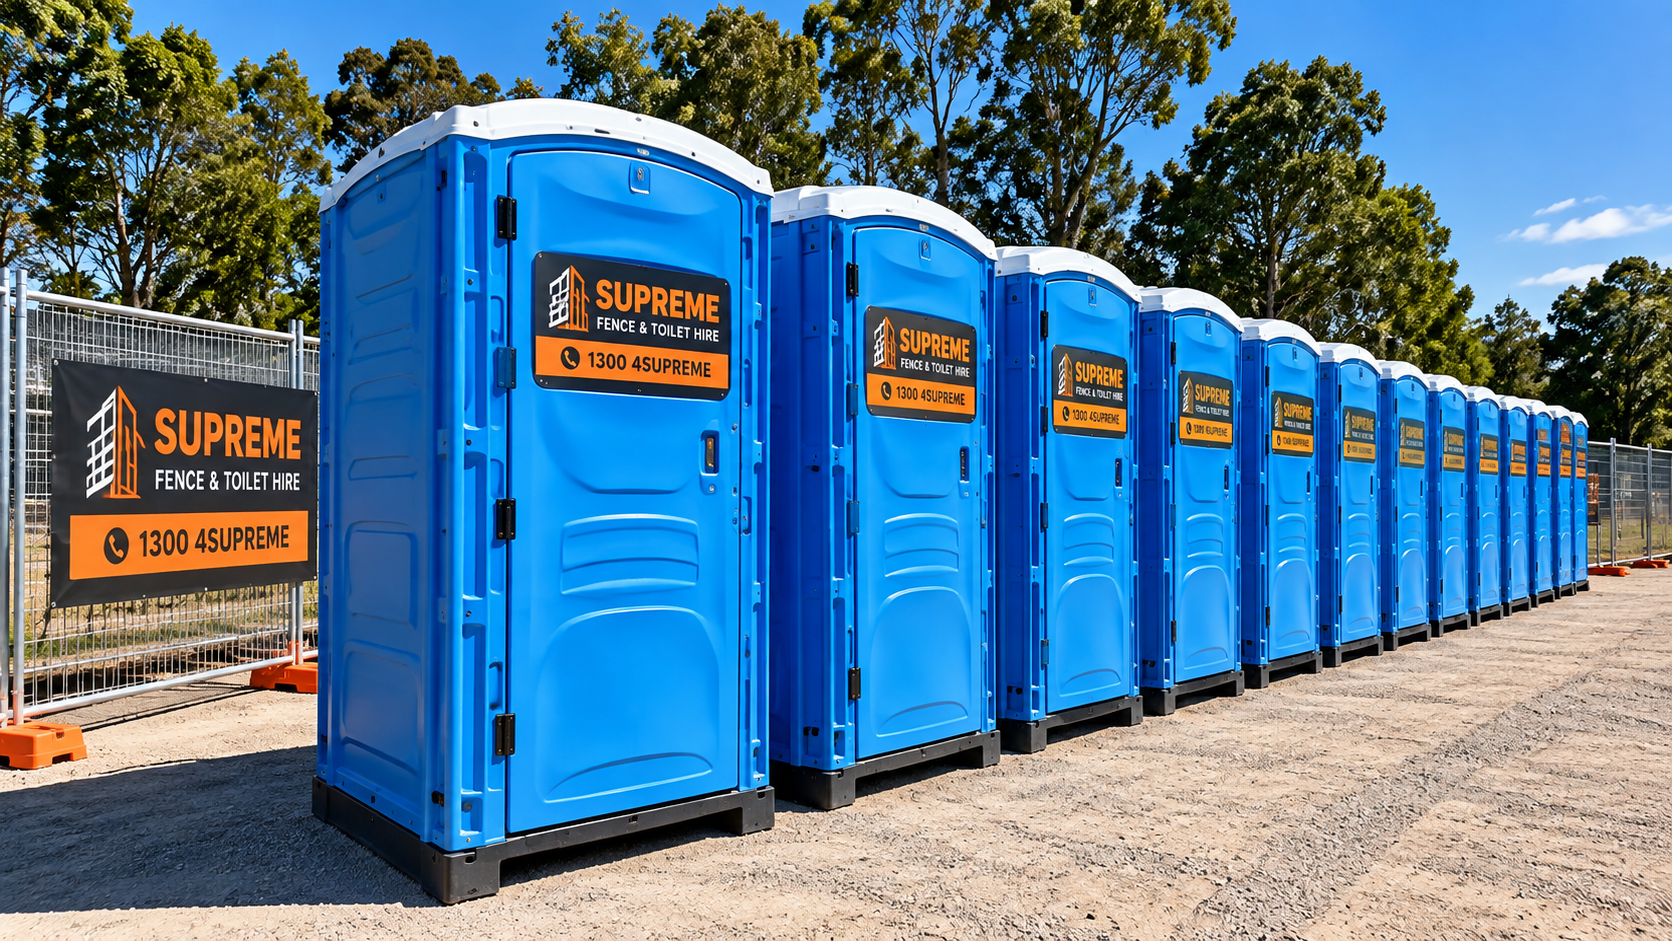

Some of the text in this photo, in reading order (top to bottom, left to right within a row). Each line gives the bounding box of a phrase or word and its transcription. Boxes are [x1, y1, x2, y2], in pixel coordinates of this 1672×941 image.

[595, 279, 720, 323] SUPREME
[596, 316, 719, 342] FENCE & TOILET HIRE
[899, 327, 970, 363] SUPREME
[588, 351, 711, 378] 1300 4SUPREME
[900, 357, 970, 378] FENCE & TOILET HIRE
[1075, 361, 1123, 389] SUPREME
[896, 386, 965, 406] 1300 4SUPREME
[154, 407, 301, 460] SUPREME
[155, 469, 300, 491] FENCE & TOILET HIRE
[139, 525, 289, 557] 1300 4SUPREME
